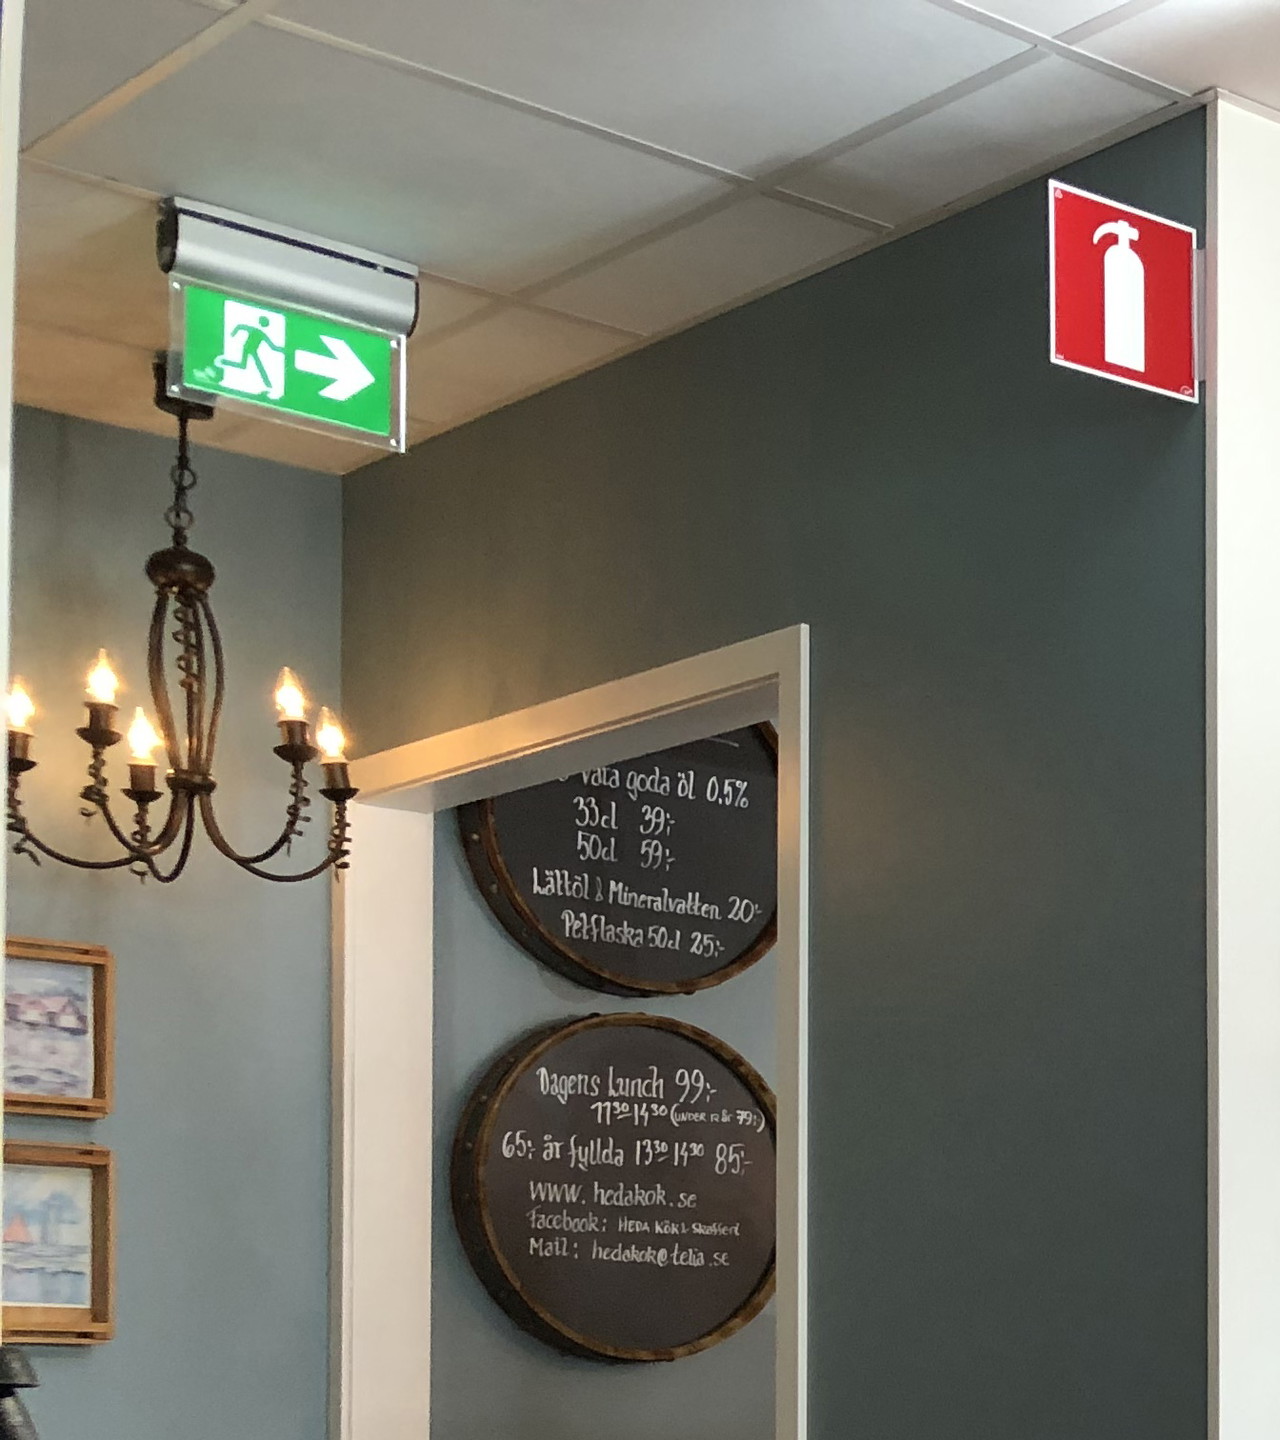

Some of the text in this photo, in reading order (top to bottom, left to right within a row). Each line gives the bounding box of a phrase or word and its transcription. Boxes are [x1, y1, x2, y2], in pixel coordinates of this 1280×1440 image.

[626, 766, 670, 801] goda
[677, 770, 696, 800] öl
[532, 867, 589, 900] Lättöl
[609, 880, 722, 920] Mineralvatten
[561, 909, 643, 948] Petflaska
[536, 1067, 600, 1104] Dagens
[607, 1066, 664, 1099] Lunch
[542, 1134, 564, 1161] år
[567, 1134, 624, 1172] fyllda
[618, 1216, 650, 1233] HEDA
[529, 1237, 578, 1260] Mail:
